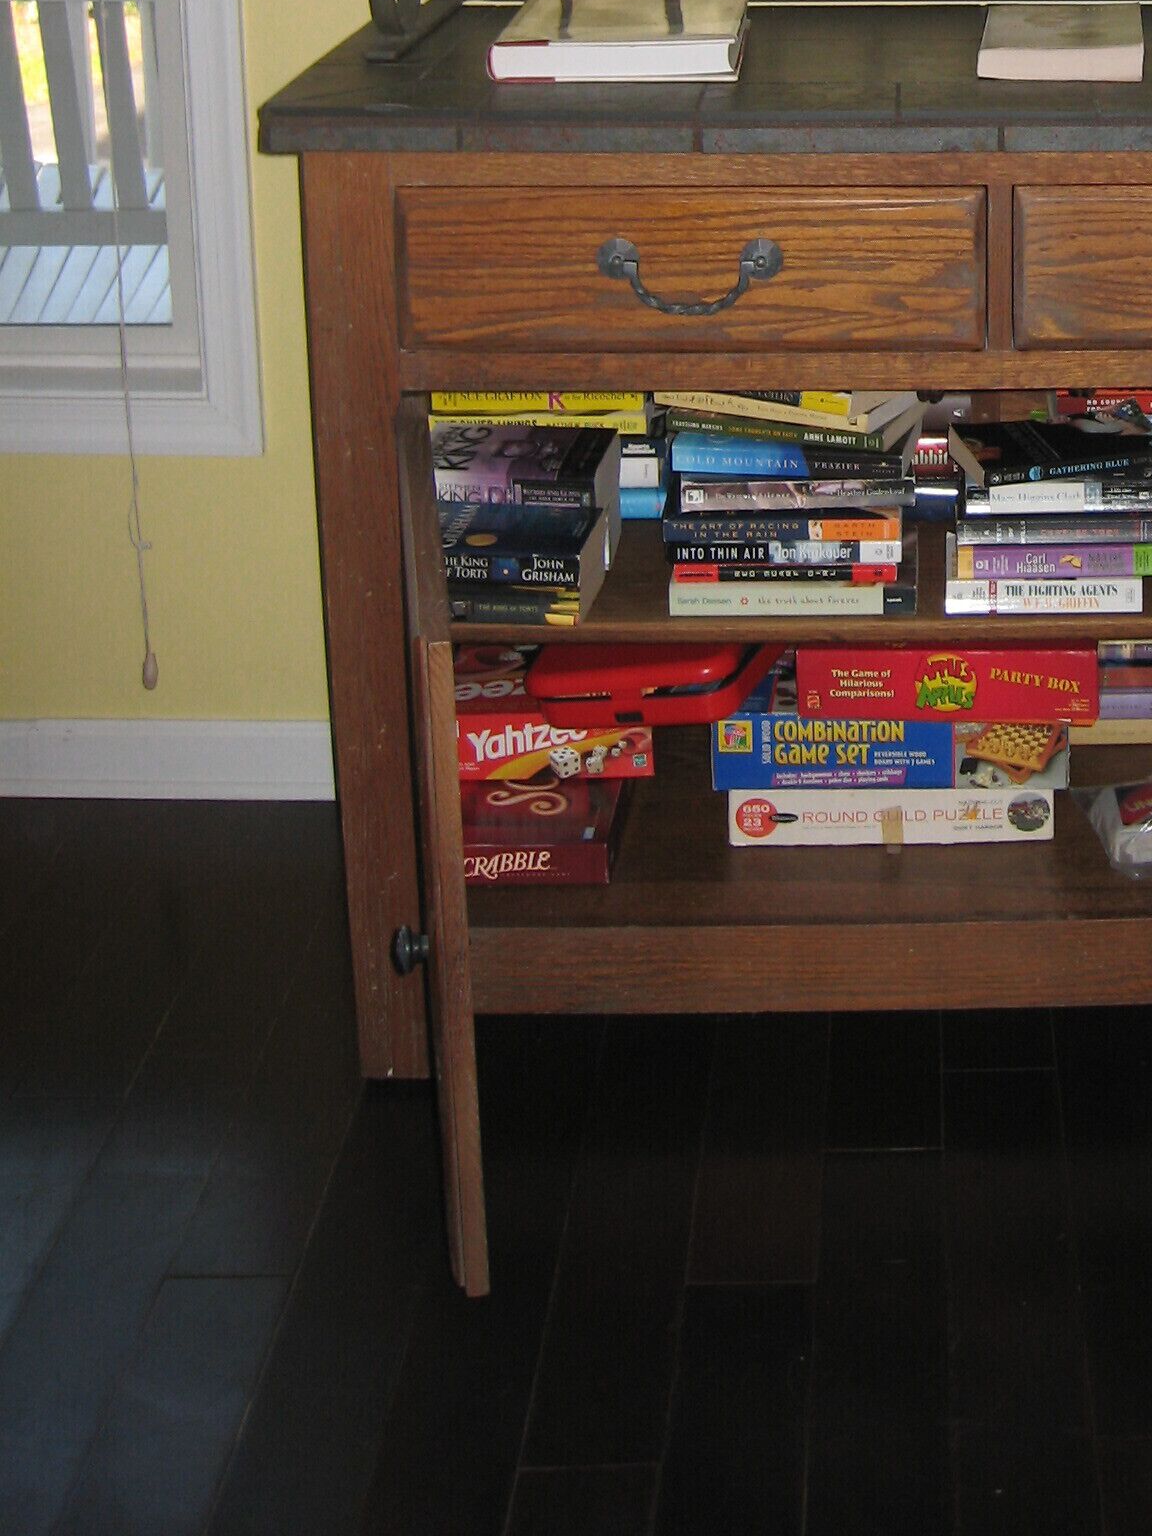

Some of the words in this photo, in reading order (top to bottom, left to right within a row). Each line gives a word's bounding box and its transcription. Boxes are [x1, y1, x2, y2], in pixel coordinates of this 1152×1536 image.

[803, 432, 824, 443] ANNE
[826, 433, 857, 446] LAMOTT
[675, 454, 716, 465] COLD
[721, 455, 799, 470] MOUNTAIN
[814, 460, 861, 471] FRAZIER
[1048, 461, 1104, 476] GATHERING
[1104, 457, 1130, 469] BLUE
[439, 490, 481, 502] KING
[673, 523, 695, 531] THE
[700, 522, 725, 531] ART
[729, 522, 745, 531] OF
[749, 522, 799, 531] RACING
[694, 530, 707, 539] IN
[714, 530, 739, 539] THE
[746, 531, 778, 539] RAIN
[676, 547, 705, 561] INTO
[709, 547, 738, 561] THIN
[742, 547, 766, 560] AIR
[1025, 553, 1046, 564] Carl
[460, 555, 488, 568] KING
[533, 556, 564, 569] JOHN
[453, 567, 488, 579] TORTS
[521, 568, 574, 582] GRISHAM
[1016, 562, 1056, 575] Hiaasen
[1005, 585, 1025, 597] THE
[1028, 584, 1077, 597] FIGHTING
[1080, 584, 1118, 596] AGENTS
[1056, 597, 1100, 610] GRIFFIN
[831, 669, 850, 678] The
[851, 669, 881, 679] Game
[882, 669, 891, 678] of
[989, 667, 1044, 688] PARTY
[1047, 676, 1081, 694] BOX
[840, 678, 884, 689] Hilarious
[829, 688, 894, 700] Comparisons!
[761, 743, 772, 764] SOLID
[802, 811, 869, 824] ROUND
[873, 810, 927, 824] GUILD
[932, 809, 1003, 822] PUZZLE
